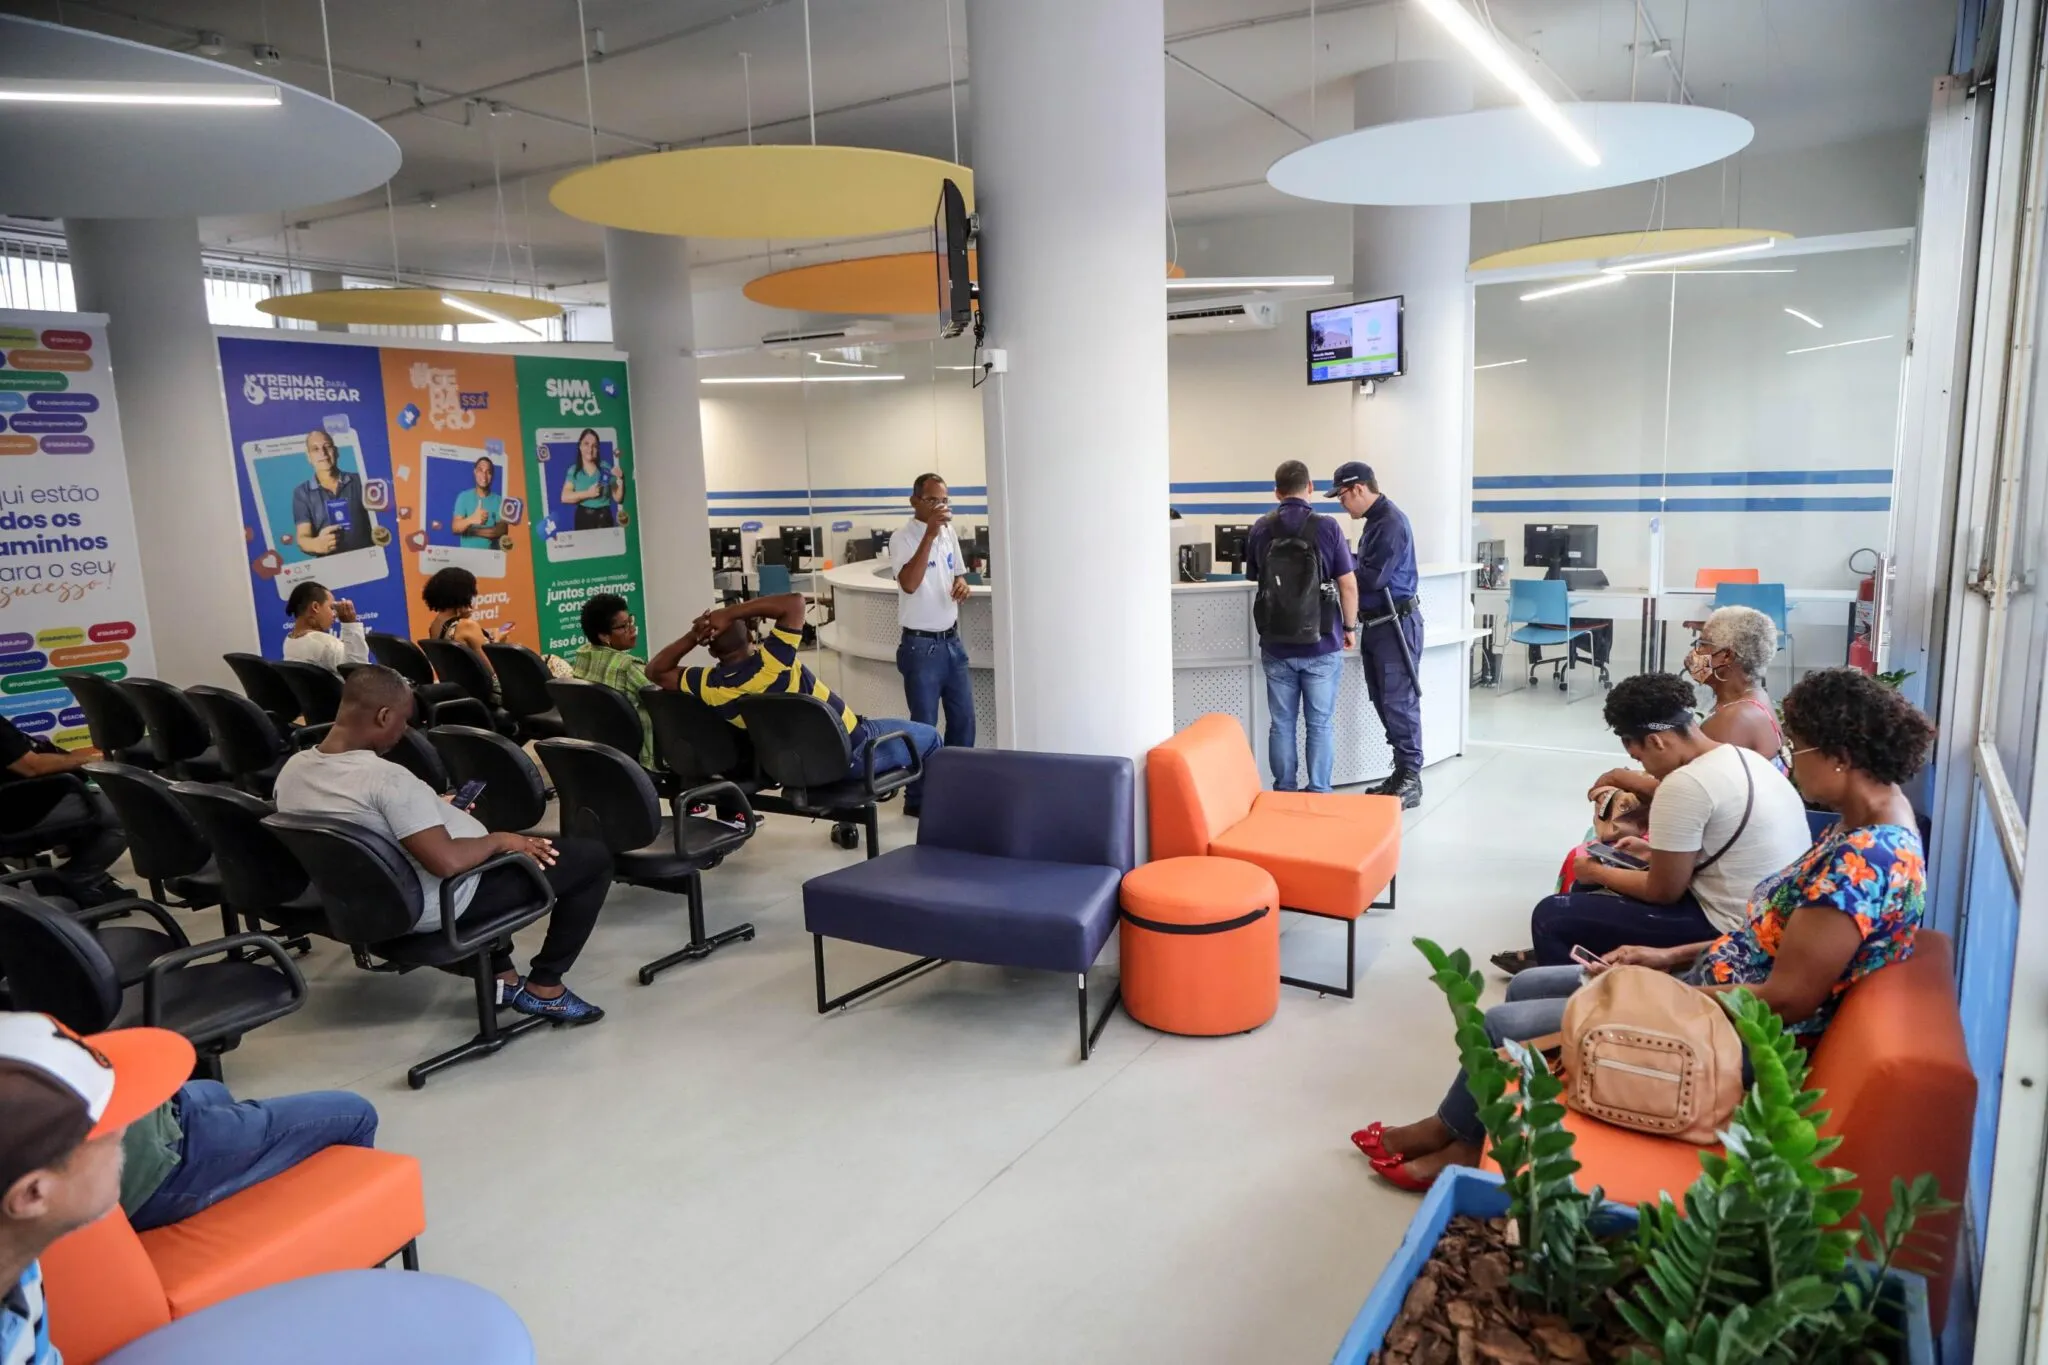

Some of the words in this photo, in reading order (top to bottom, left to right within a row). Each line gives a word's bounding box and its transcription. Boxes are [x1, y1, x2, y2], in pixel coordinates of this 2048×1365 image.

[256, 374, 325, 388] TREINAR
[325, 380, 348, 388] PARA
[545, 378, 592, 398] SIMM
[268, 387, 361, 402] EMPREGAR
[0, 485, 24, 510] ui
[31, 485, 99, 504] estão
[0, 511, 48, 531] dos
[51, 512, 82, 528] os
[0, 533, 108, 556] aminhos
[0, 565, 42, 582] ara
[48, 563, 65, 578] o
[70, 560, 113, 577] seu
[471, 591, 510, 610] para,
[545, 588, 585, 607] juntos
[586, 581, 636, 597] estamos
[355, 611, 379, 622] quiste
[471, 605, 499, 621] era!
[550, 637, 570, 649] isso
[570, 634, 577, 646] é
